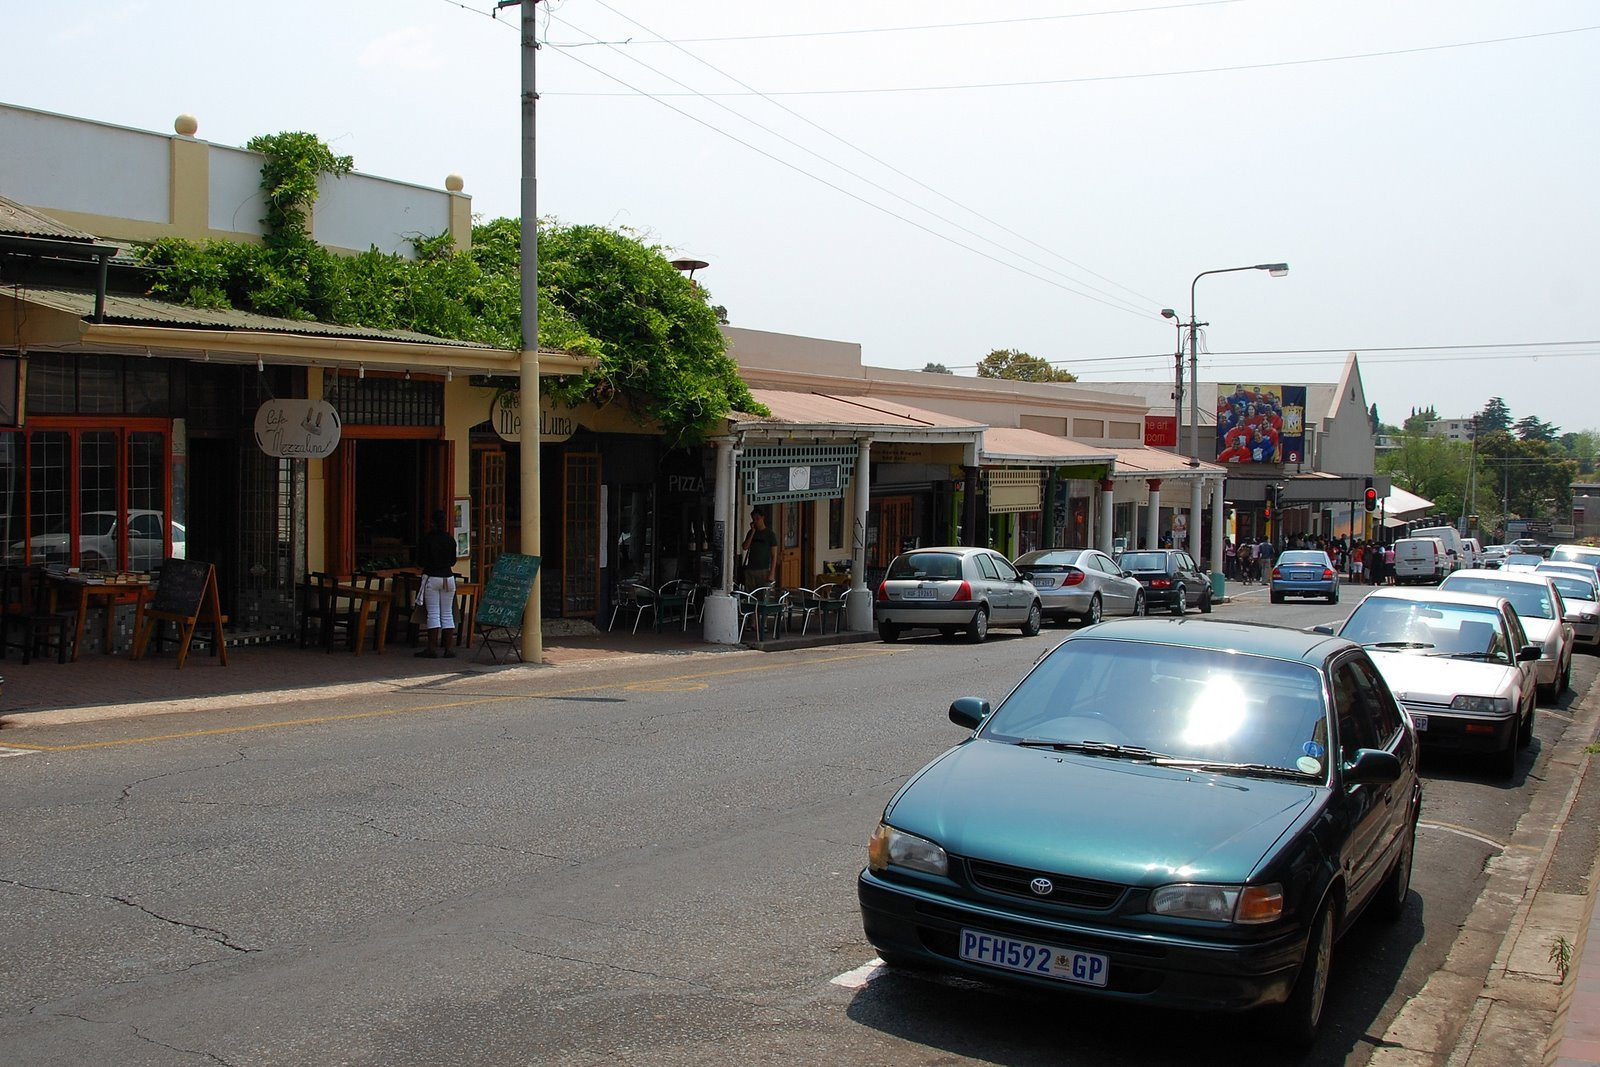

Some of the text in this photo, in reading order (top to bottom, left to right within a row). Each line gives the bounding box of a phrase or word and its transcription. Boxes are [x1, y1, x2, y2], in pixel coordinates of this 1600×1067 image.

[1157, 420, 1169, 430] art
[1289, 452, 1297, 462] e
[669, 474, 705, 494] PIZZA
[1415, 717, 1427, 729] GP
[964, 932, 1103, 981] PFH592 GP
